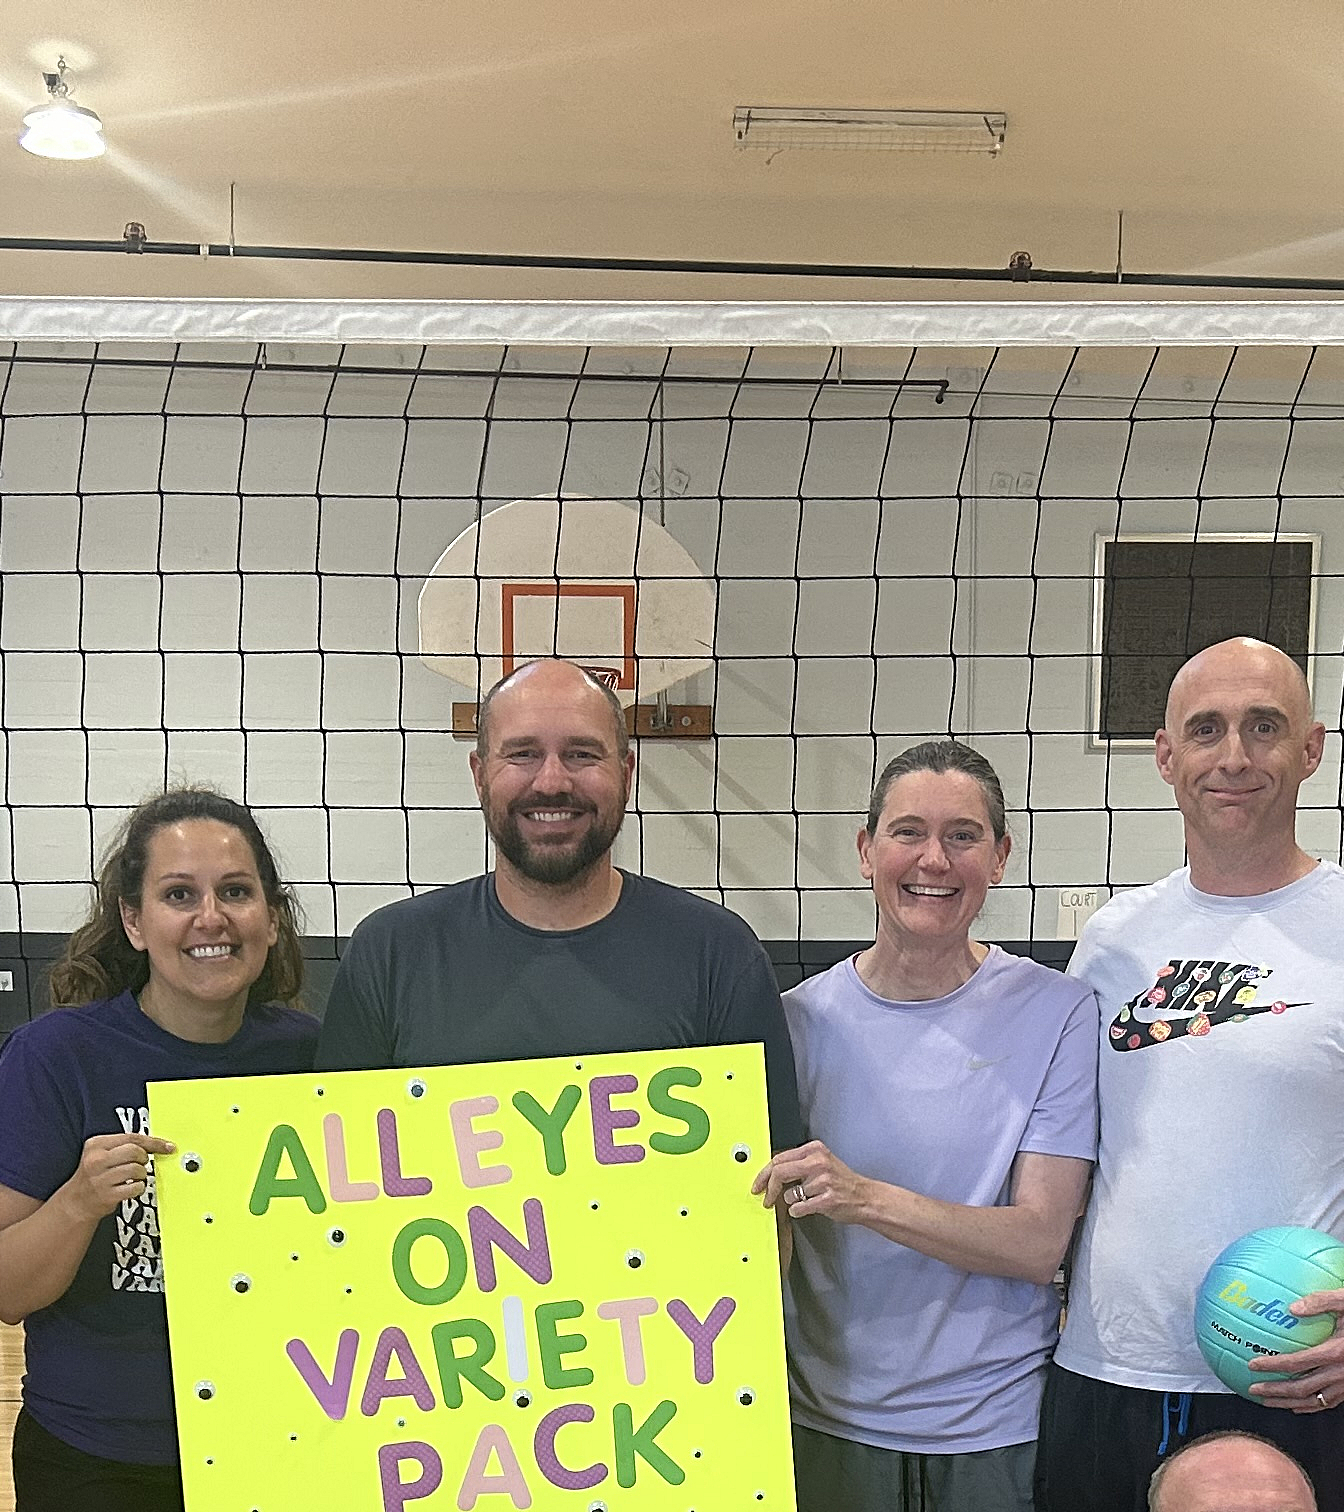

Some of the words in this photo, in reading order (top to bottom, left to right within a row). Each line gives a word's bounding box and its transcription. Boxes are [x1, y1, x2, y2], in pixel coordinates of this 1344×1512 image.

[1060, 890, 1097, 908] COURT
[1138, 959, 1274, 1011] NIKE
[248, 1108, 433, 1217] ALL
[449, 1065, 711, 1189] EYES
[392, 1198, 553, 1306] ON
[1218, 1280, 1299, 1330] Baden
[286, 1296, 737, 1421] VARIETY
[1211, 1321, 1242, 1345] MATCH
